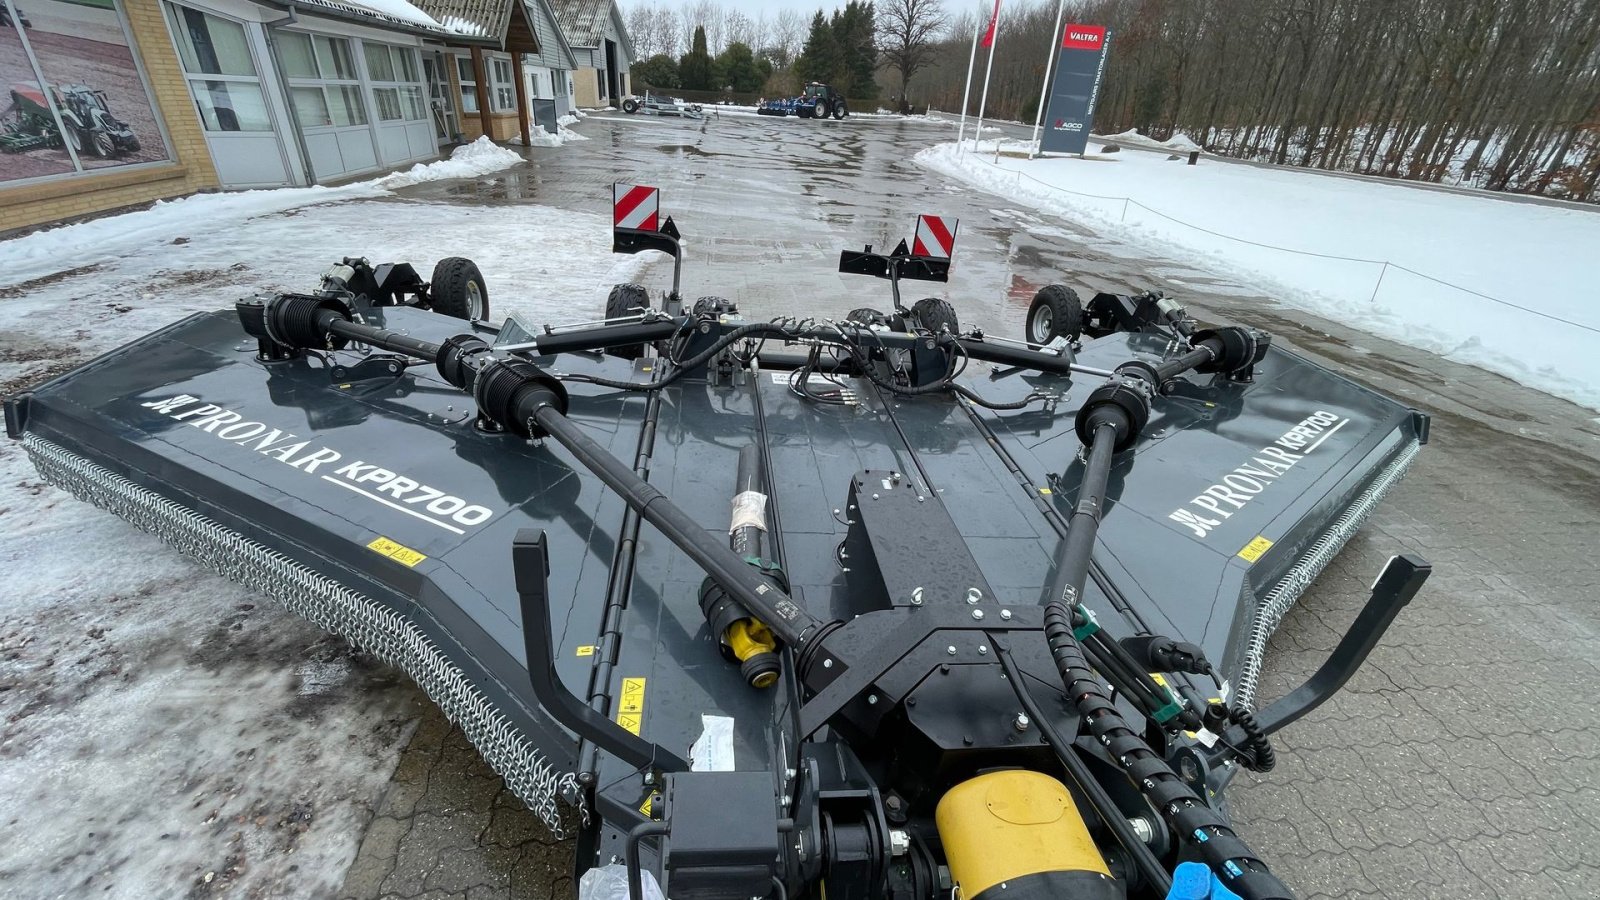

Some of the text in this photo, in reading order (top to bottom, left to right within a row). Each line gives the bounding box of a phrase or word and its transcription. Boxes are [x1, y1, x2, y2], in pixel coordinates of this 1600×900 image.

[1070, 31, 1098, 42] VALTRA
[173, 404, 493, 526] PRONAR KPR700
[1190, 410, 1339, 519] PRONAR KPR700
